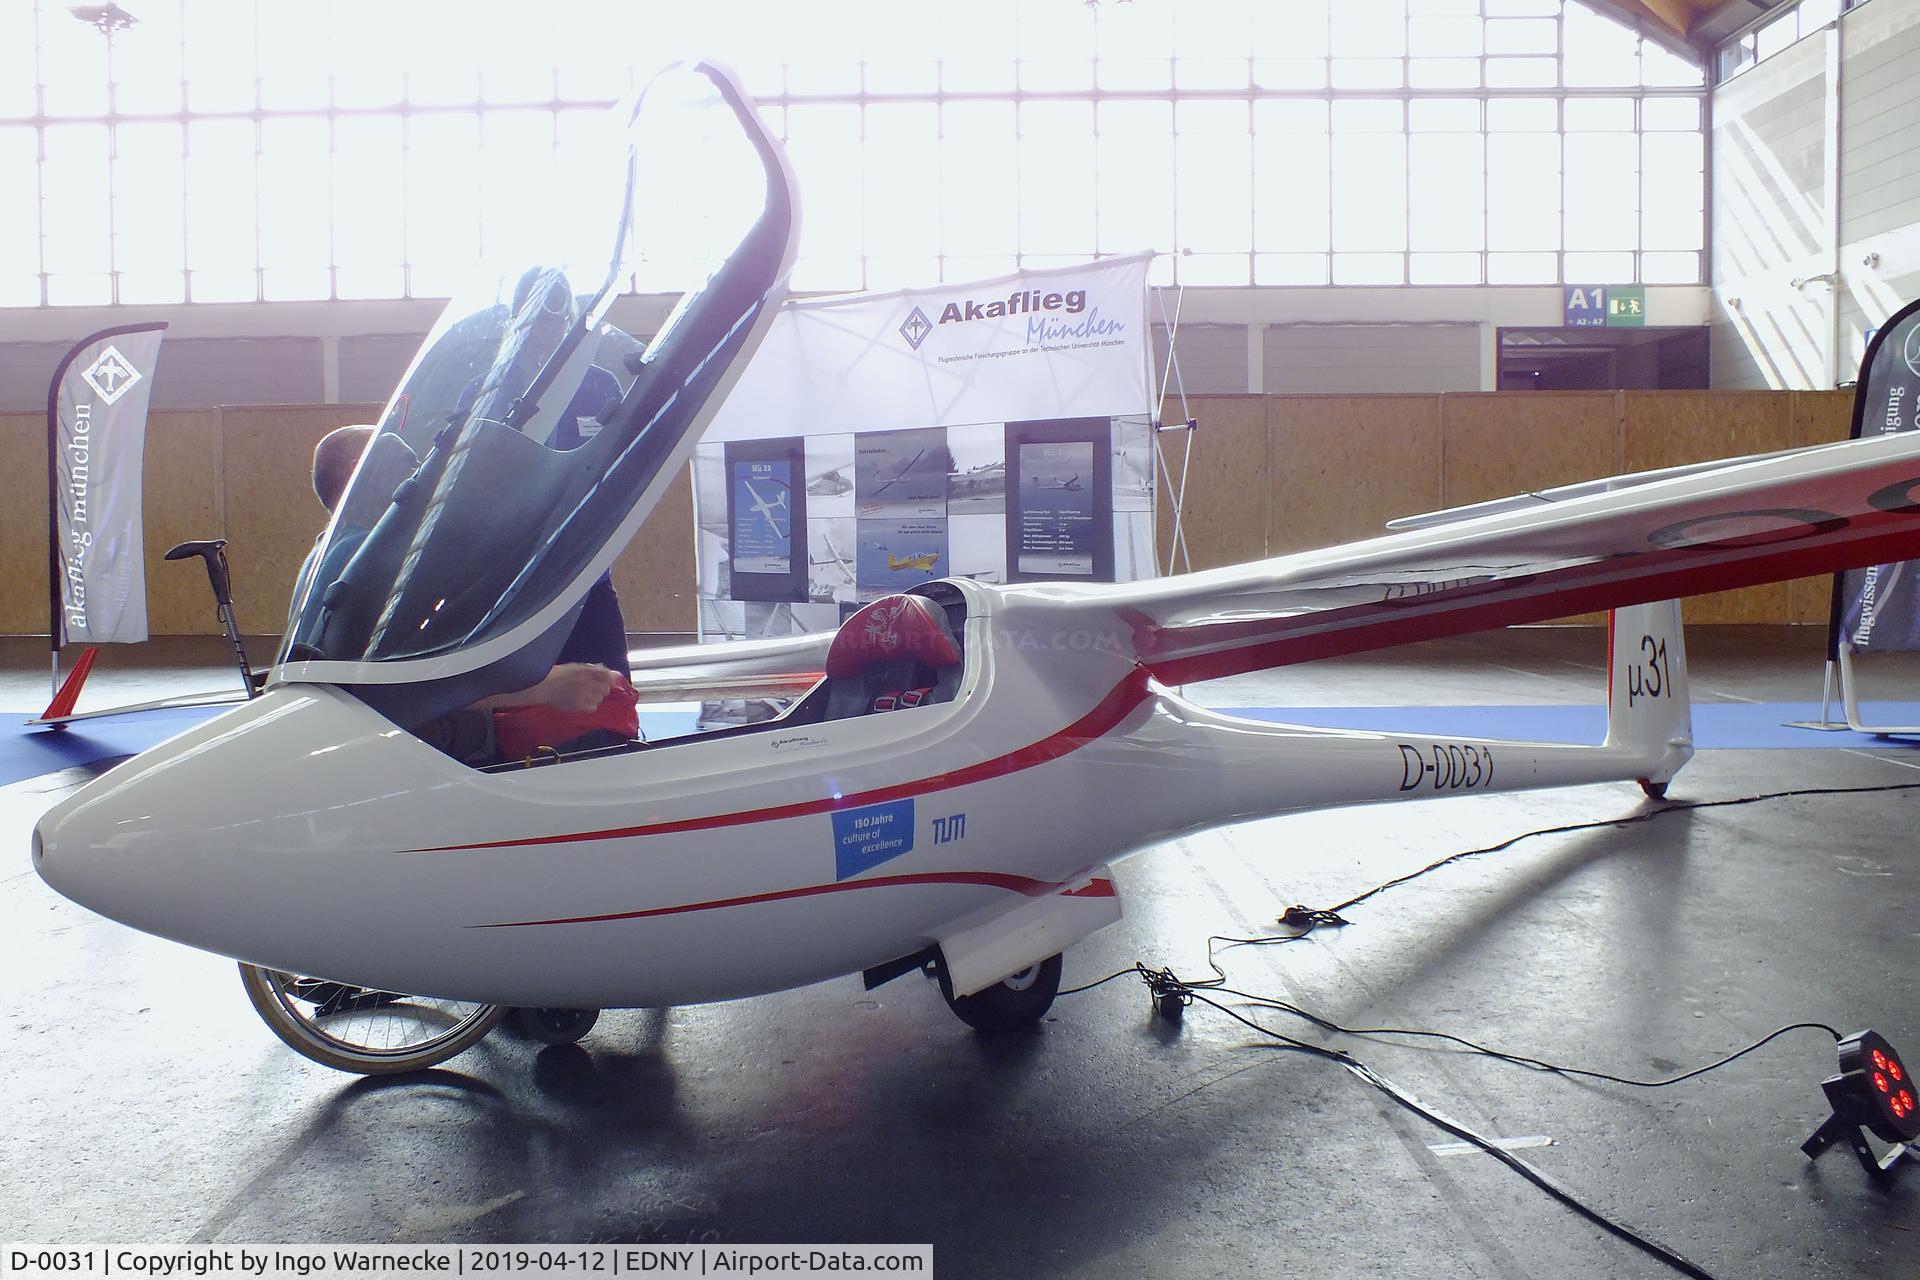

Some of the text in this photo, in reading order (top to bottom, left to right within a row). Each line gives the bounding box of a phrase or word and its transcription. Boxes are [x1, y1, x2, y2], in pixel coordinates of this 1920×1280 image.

[938, 289, 1086, 324] Akaflieg
[1568, 288, 1603, 309] A1
[1026, 306, 1125, 345] München
[974, 349, 1020, 359] Forschungsgruppe
[1030, 345, 1039, 353] der
[1040, 342, 1070, 352] Technischen
[1101, 338, 1125, 347] München
[69, 403, 92, 526] münchen
[1398, 744, 1493, 792] D-0031
[855, 814, 894, 829] 150 Jahre
[842, 828, 881, 845] culture of
[861, 838, 903, 854] excellence
